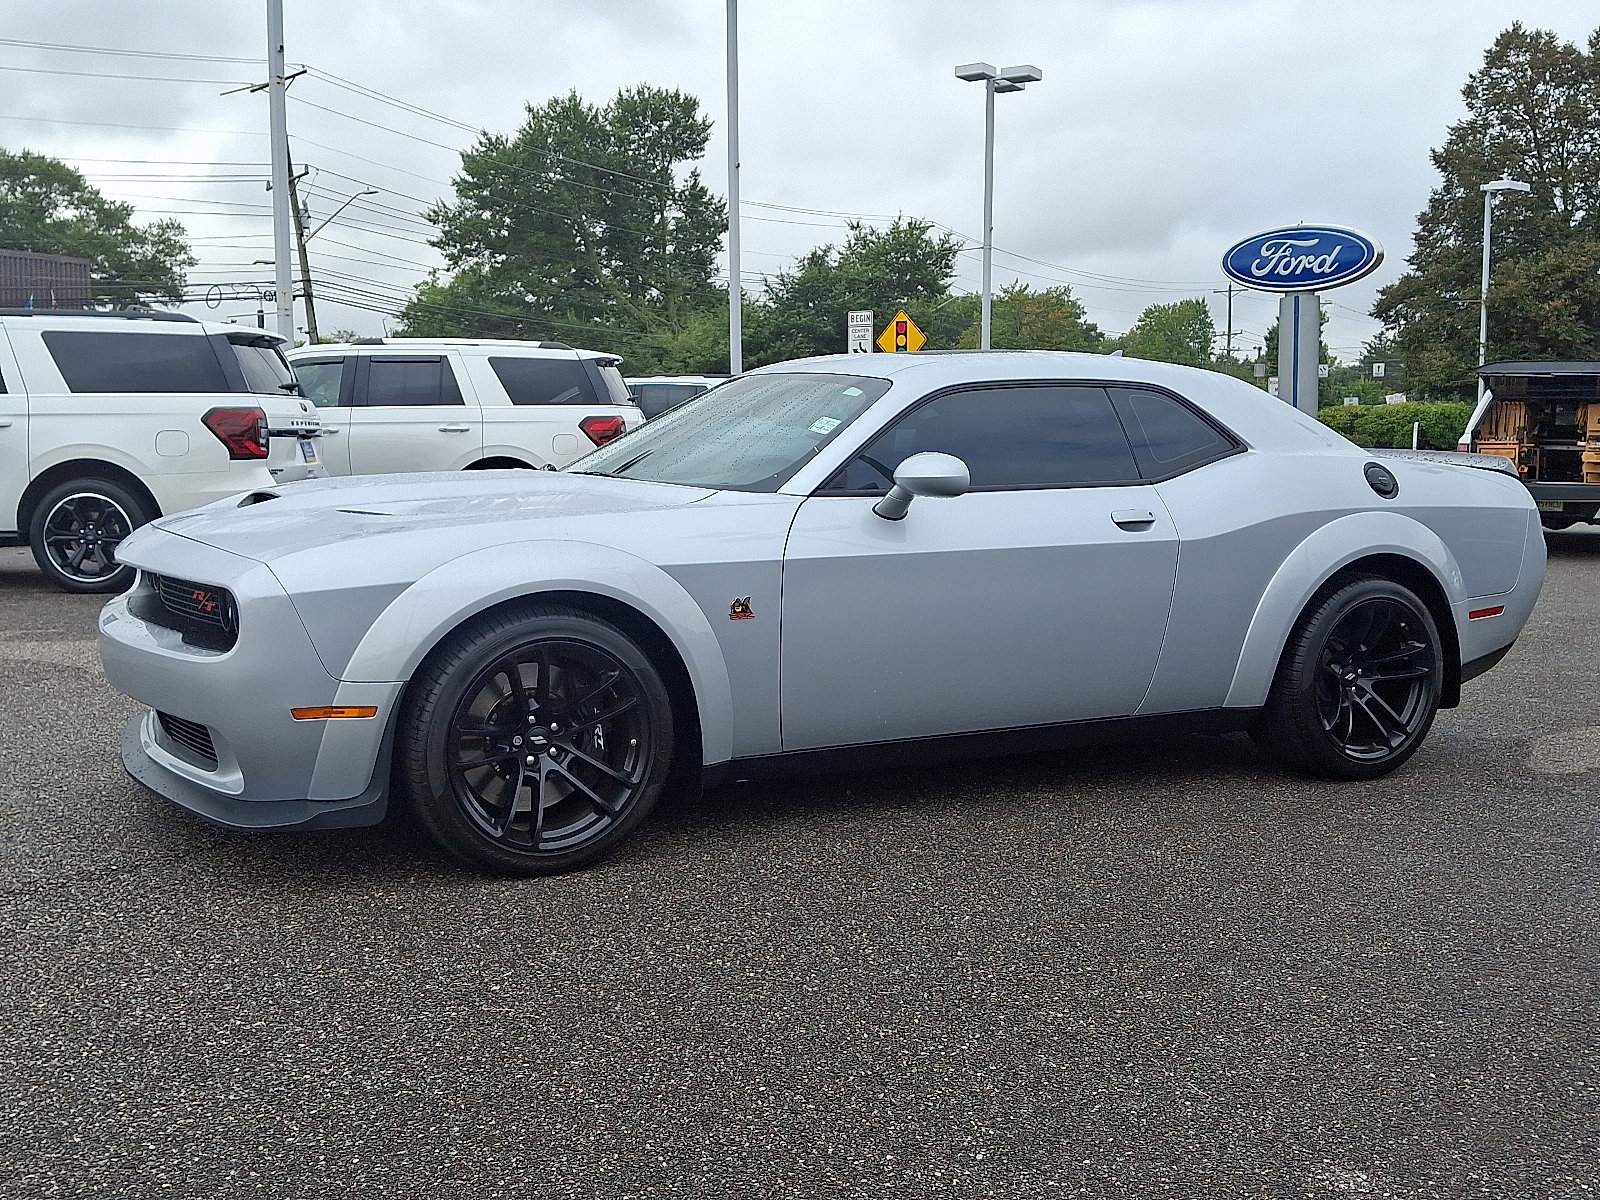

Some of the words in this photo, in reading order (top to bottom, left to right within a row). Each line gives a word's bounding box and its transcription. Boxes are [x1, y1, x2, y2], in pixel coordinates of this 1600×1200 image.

[1251, 238, 1343, 277] Ford
[851, 314, 871, 323] BEGIN
[192, 590, 216, 612] R/T
